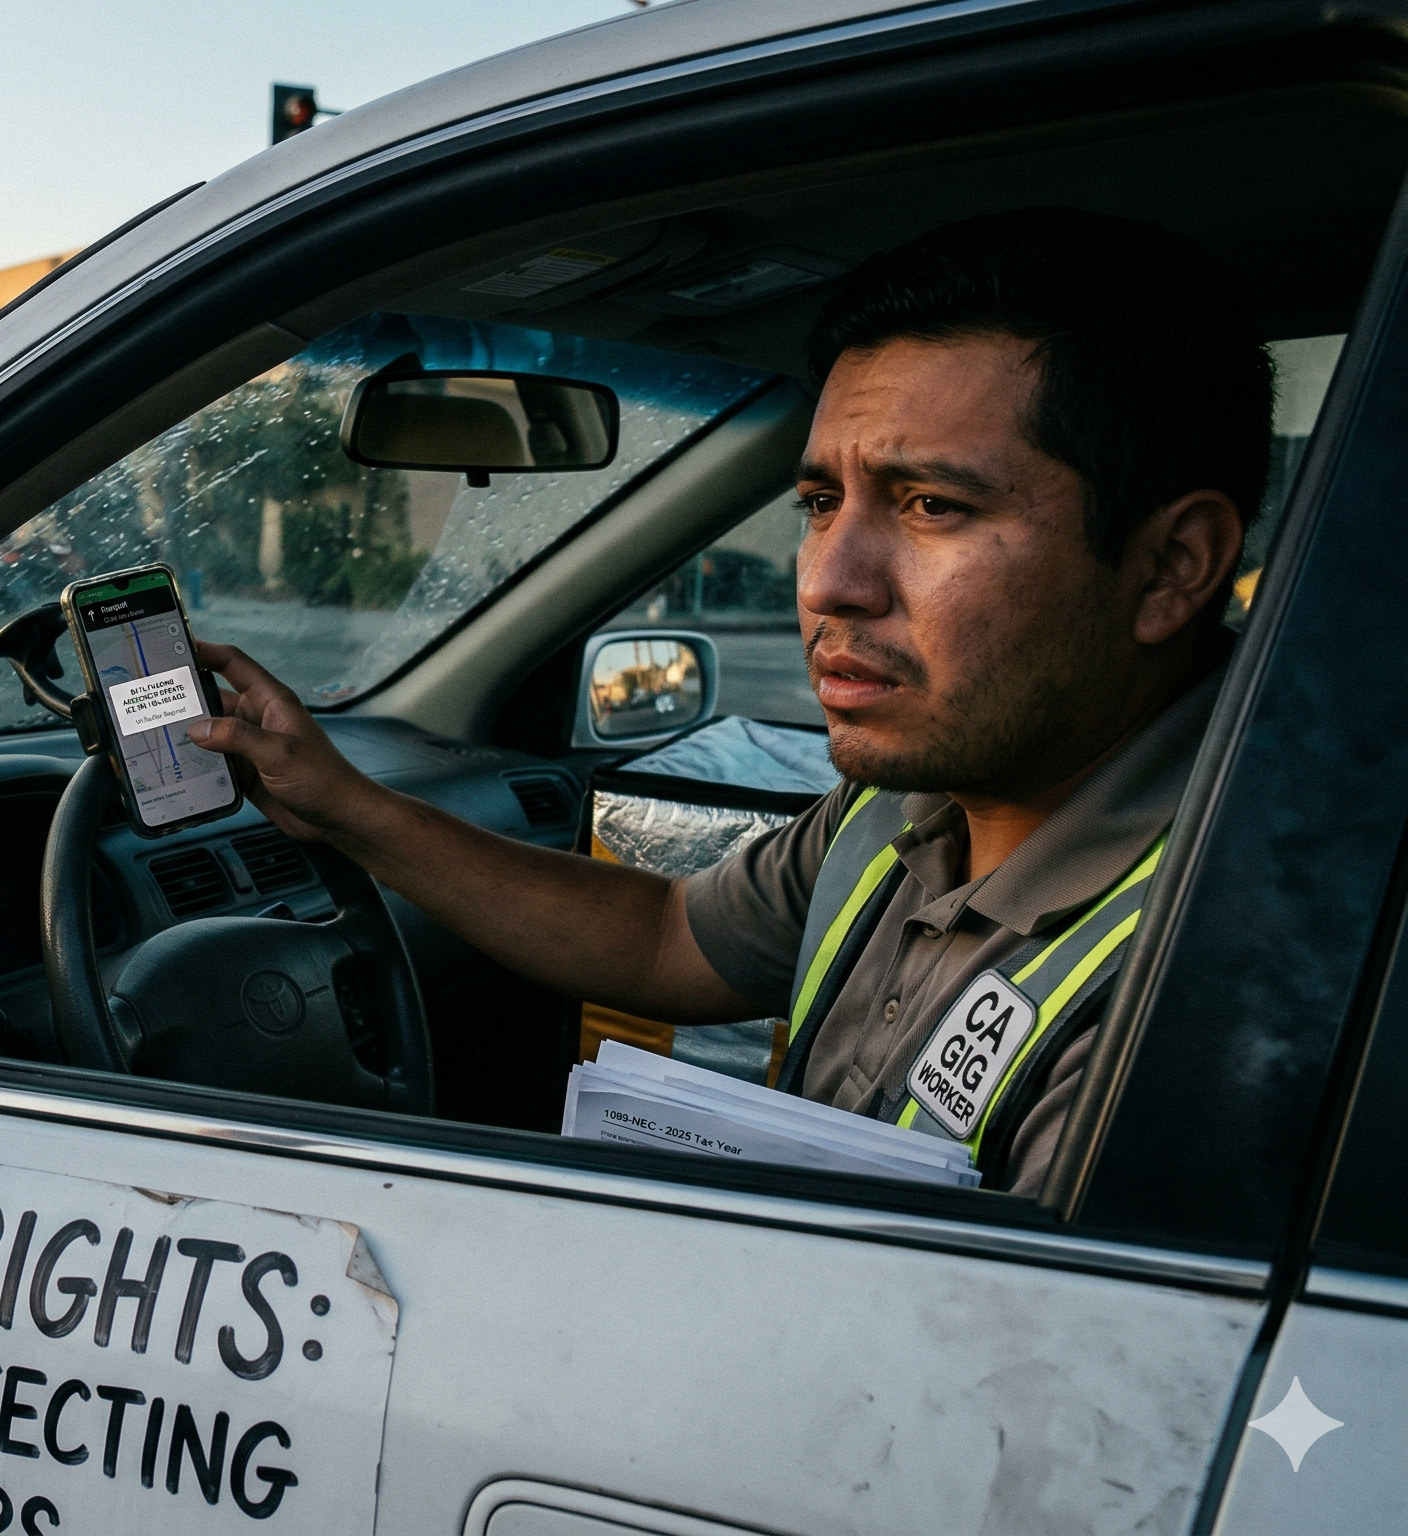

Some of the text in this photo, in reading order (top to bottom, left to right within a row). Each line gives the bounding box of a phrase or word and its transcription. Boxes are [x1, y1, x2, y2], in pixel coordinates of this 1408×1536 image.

[965, 991, 1015, 1056] CA
[917, 1059, 975, 1127] WORKER
[940, 1034, 988, 1094] GIG
[665, 1126, 692, 1142] 2025
[694, 1133, 714, 1148] Tax
[717, 1140, 743, 1156] Year
